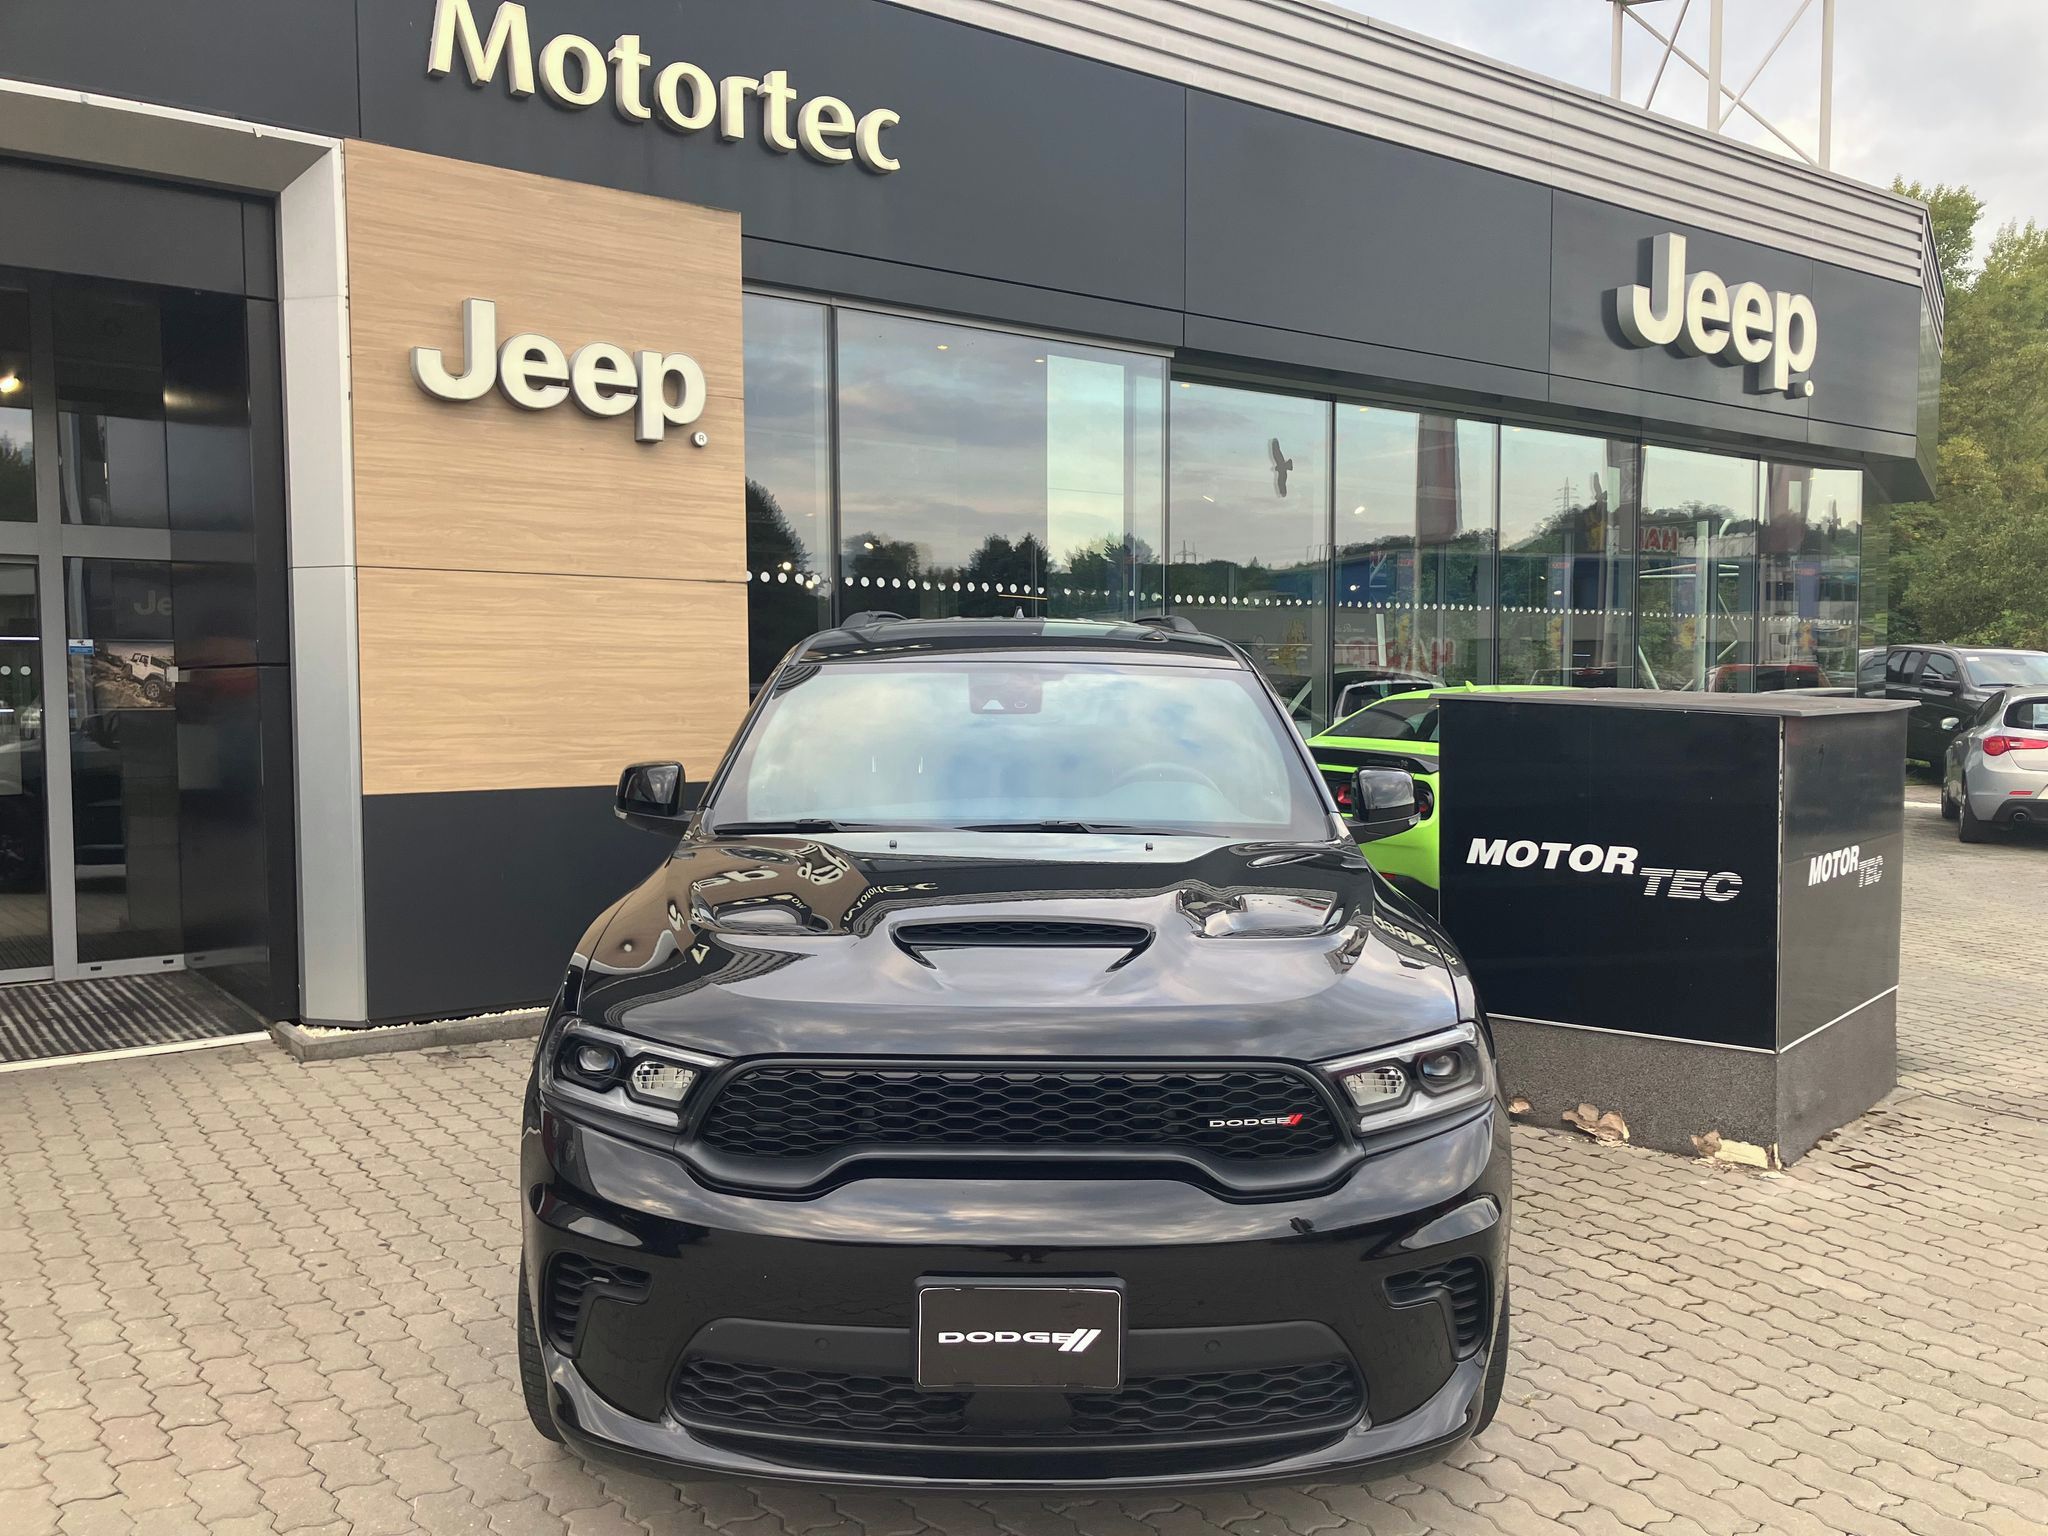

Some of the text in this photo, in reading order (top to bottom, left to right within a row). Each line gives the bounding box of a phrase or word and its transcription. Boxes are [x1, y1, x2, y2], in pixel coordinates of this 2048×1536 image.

[427, 0, 901, 173] Motortec
[1616, 232, 1818, 392] Jeep
[410, 298, 708, 443] Jeep
[1466, 837, 1639, 875] MOTOR
[1808, 845, 1860, 886] MOTOR
[1209, 1117, 1291, 1128] DODGE
[938, 1331, 1073, 1344] DODGE
